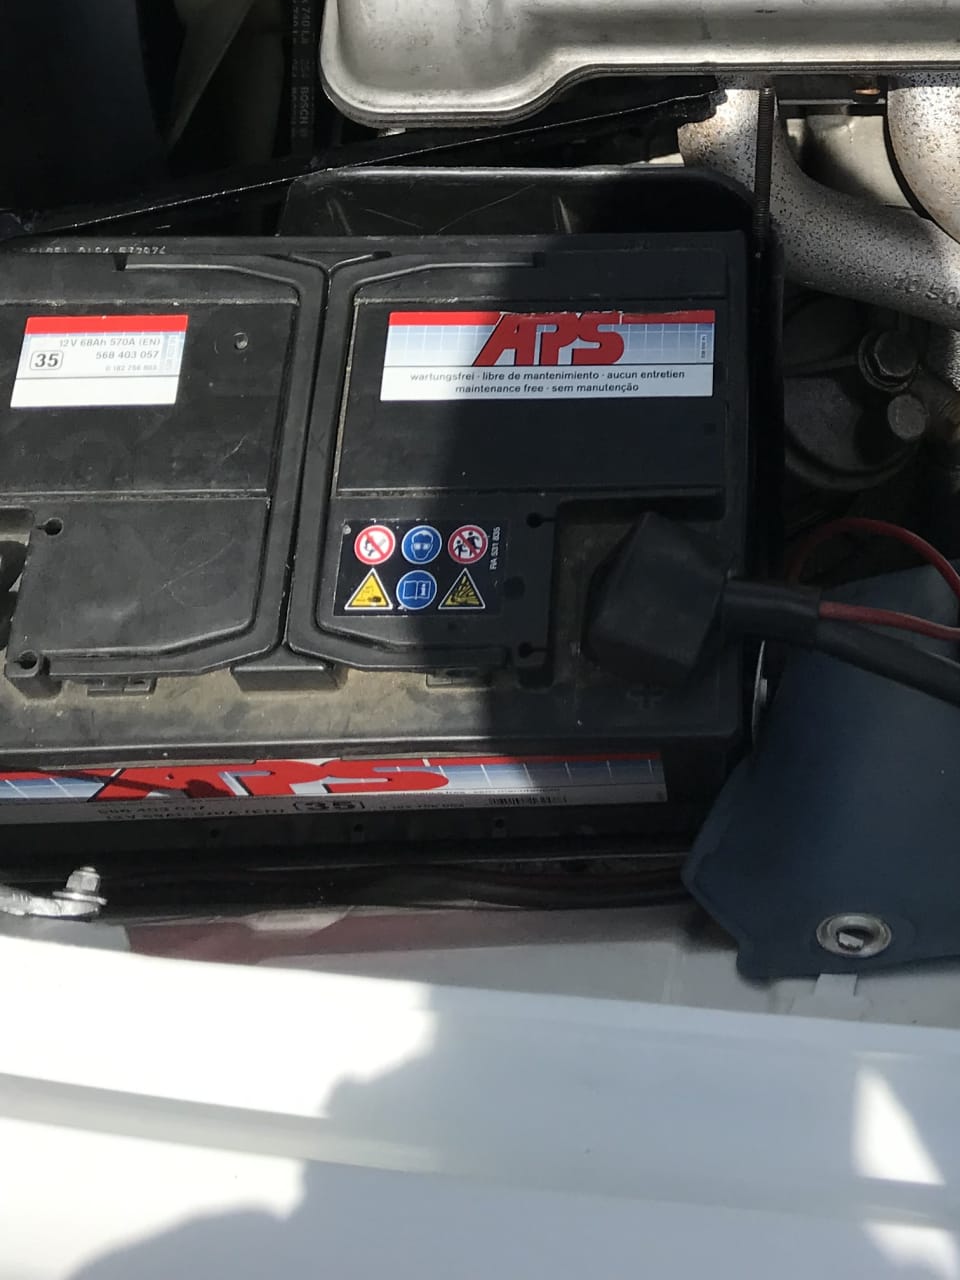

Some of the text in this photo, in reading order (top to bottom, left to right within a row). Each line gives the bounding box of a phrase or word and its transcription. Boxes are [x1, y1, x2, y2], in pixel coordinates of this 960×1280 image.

[299, 86, 310, 125] BOSCH
[60, 337, 161, 348] 12V 68Ah 570A (EN)
[471, 311, 625, 367] APS
[34, 352, 60, 369] 35
[95, 350, 160, 360] 568 403 057
[410, 369, 686, 383] wartungsfrei libre de mantenimiento aucun entretien
[455, 382, 640, 393] maintenance free sem manutenção
[87, 756, 450, 803] APS
